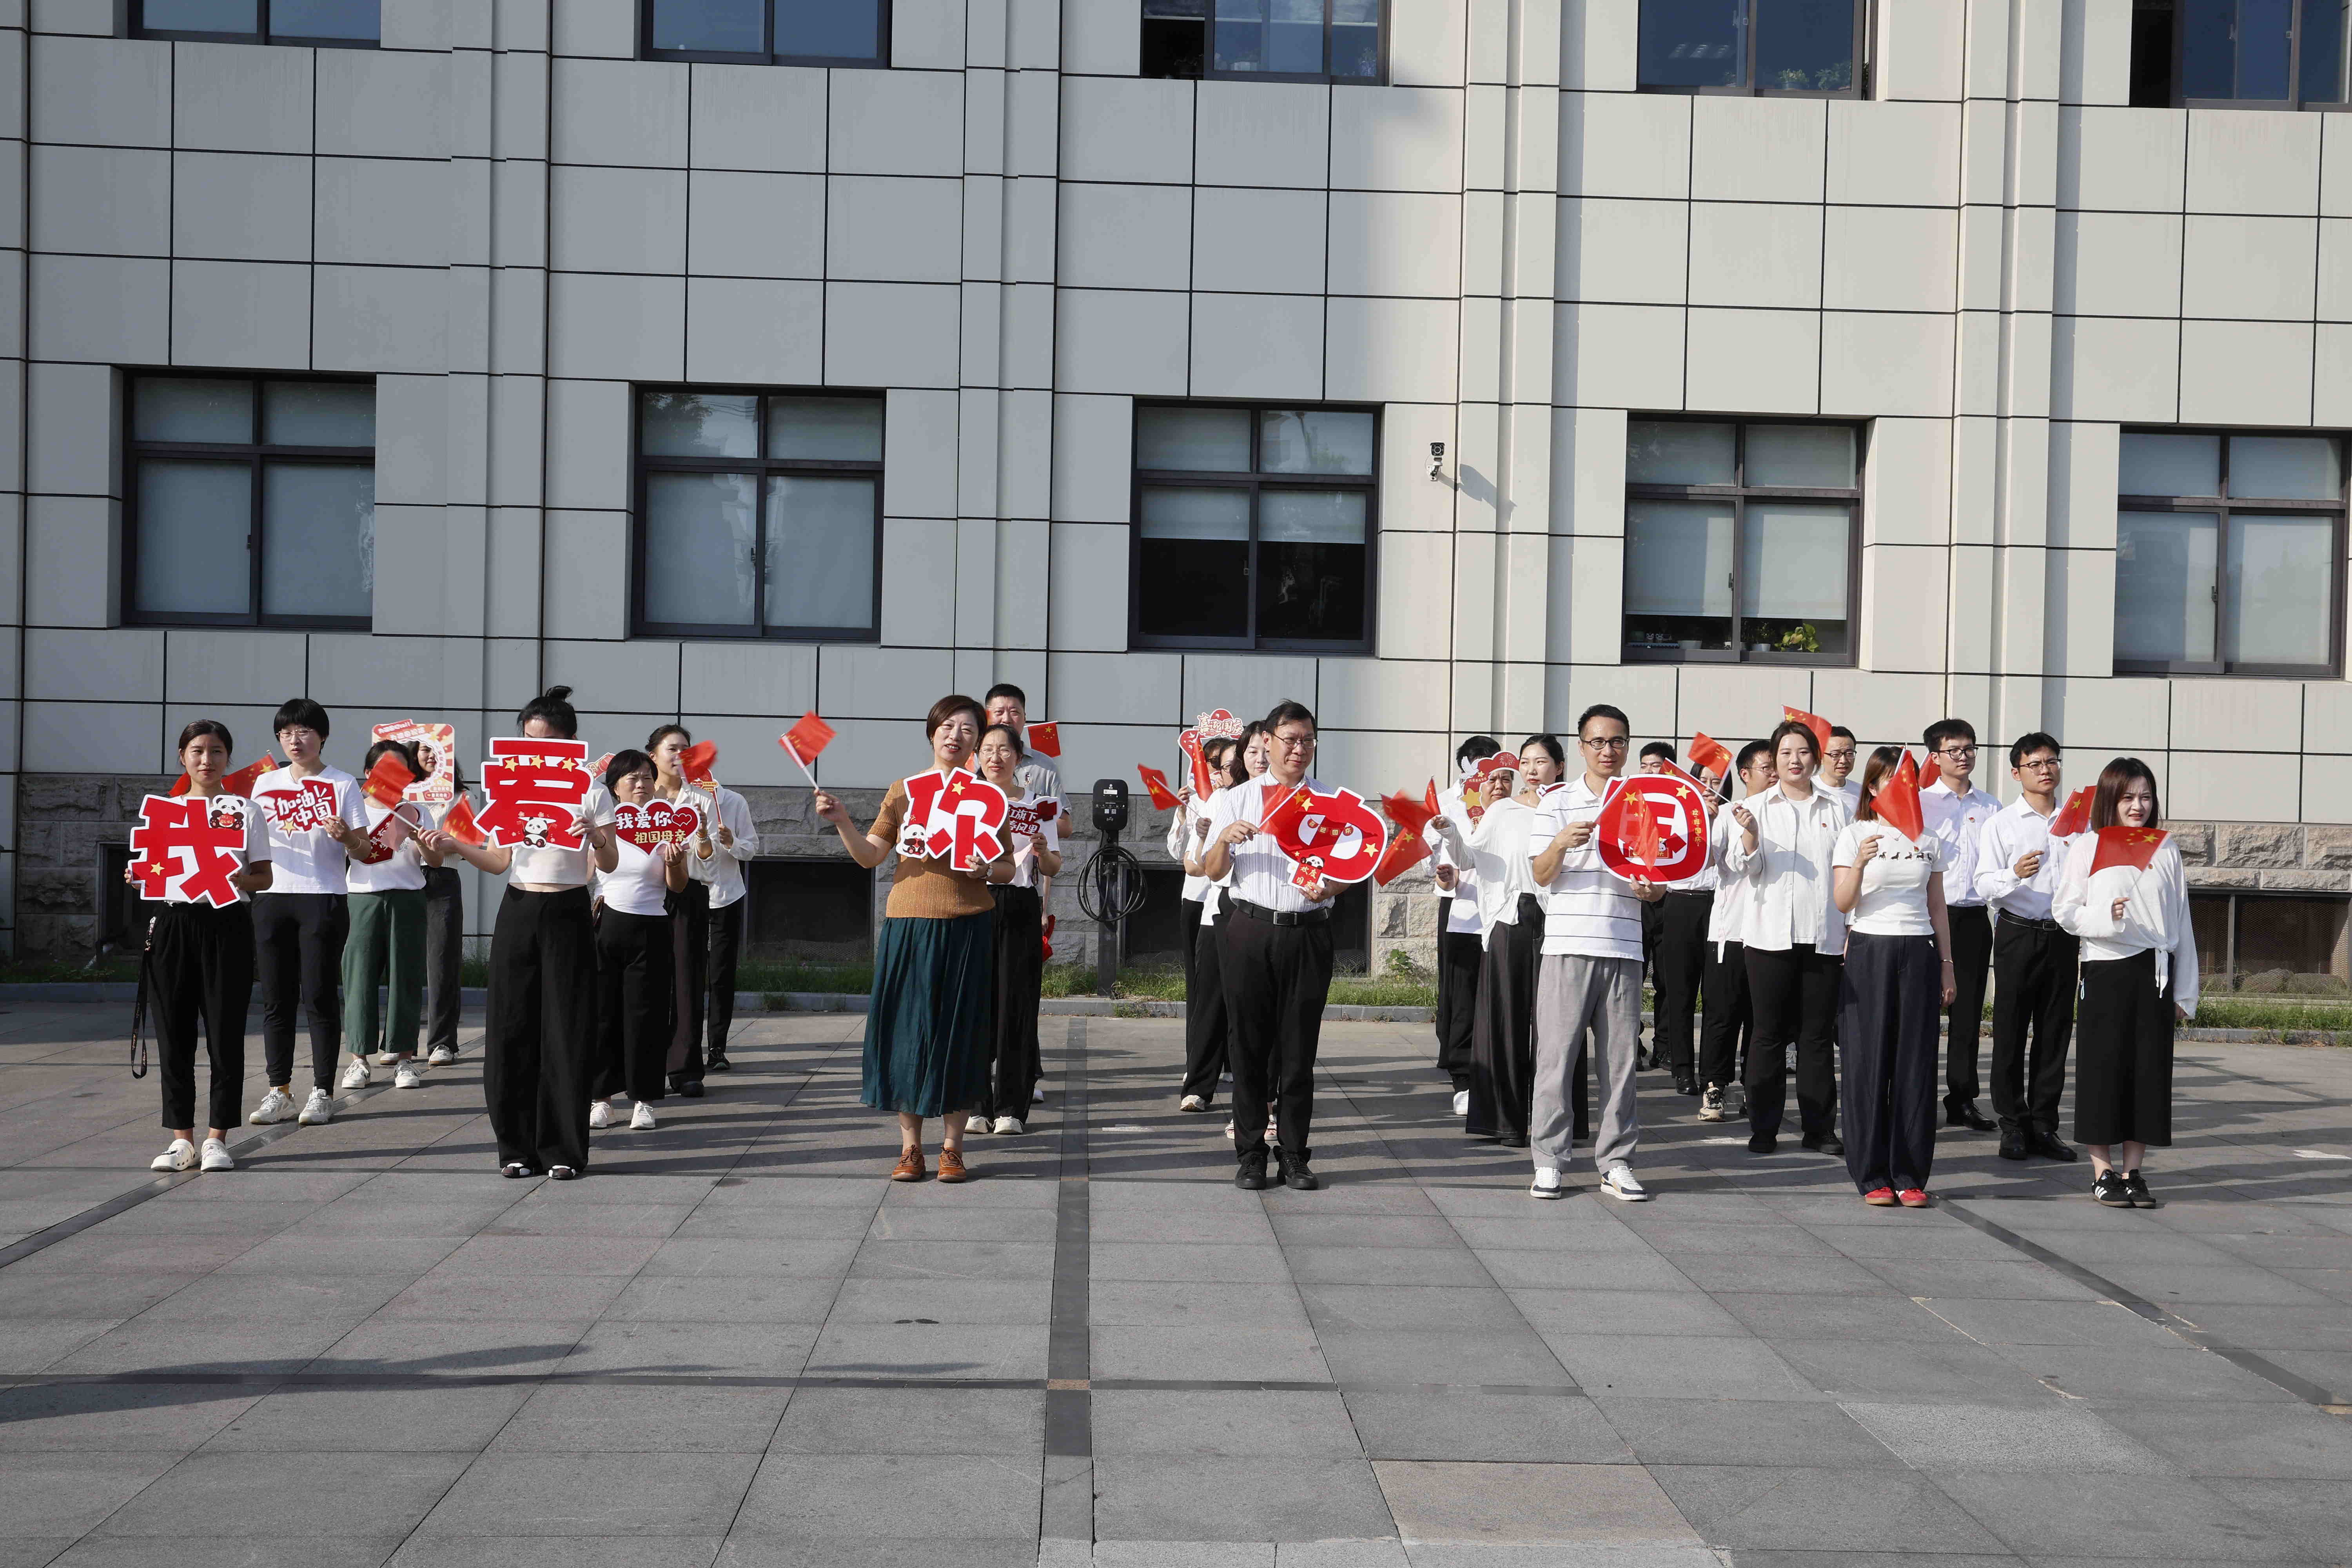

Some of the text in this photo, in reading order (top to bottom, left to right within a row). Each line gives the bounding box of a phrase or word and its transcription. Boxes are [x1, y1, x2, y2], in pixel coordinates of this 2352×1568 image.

[295, 801, 332, 826] 中国
[475, 739, 592, 850] 爱
[616, 811, 672, 830] 我爱你
[906, 771, 1004, 869] 你
[131, 797, 245, 906] 我
[634, 829, 687, 844] 祖国母亲
